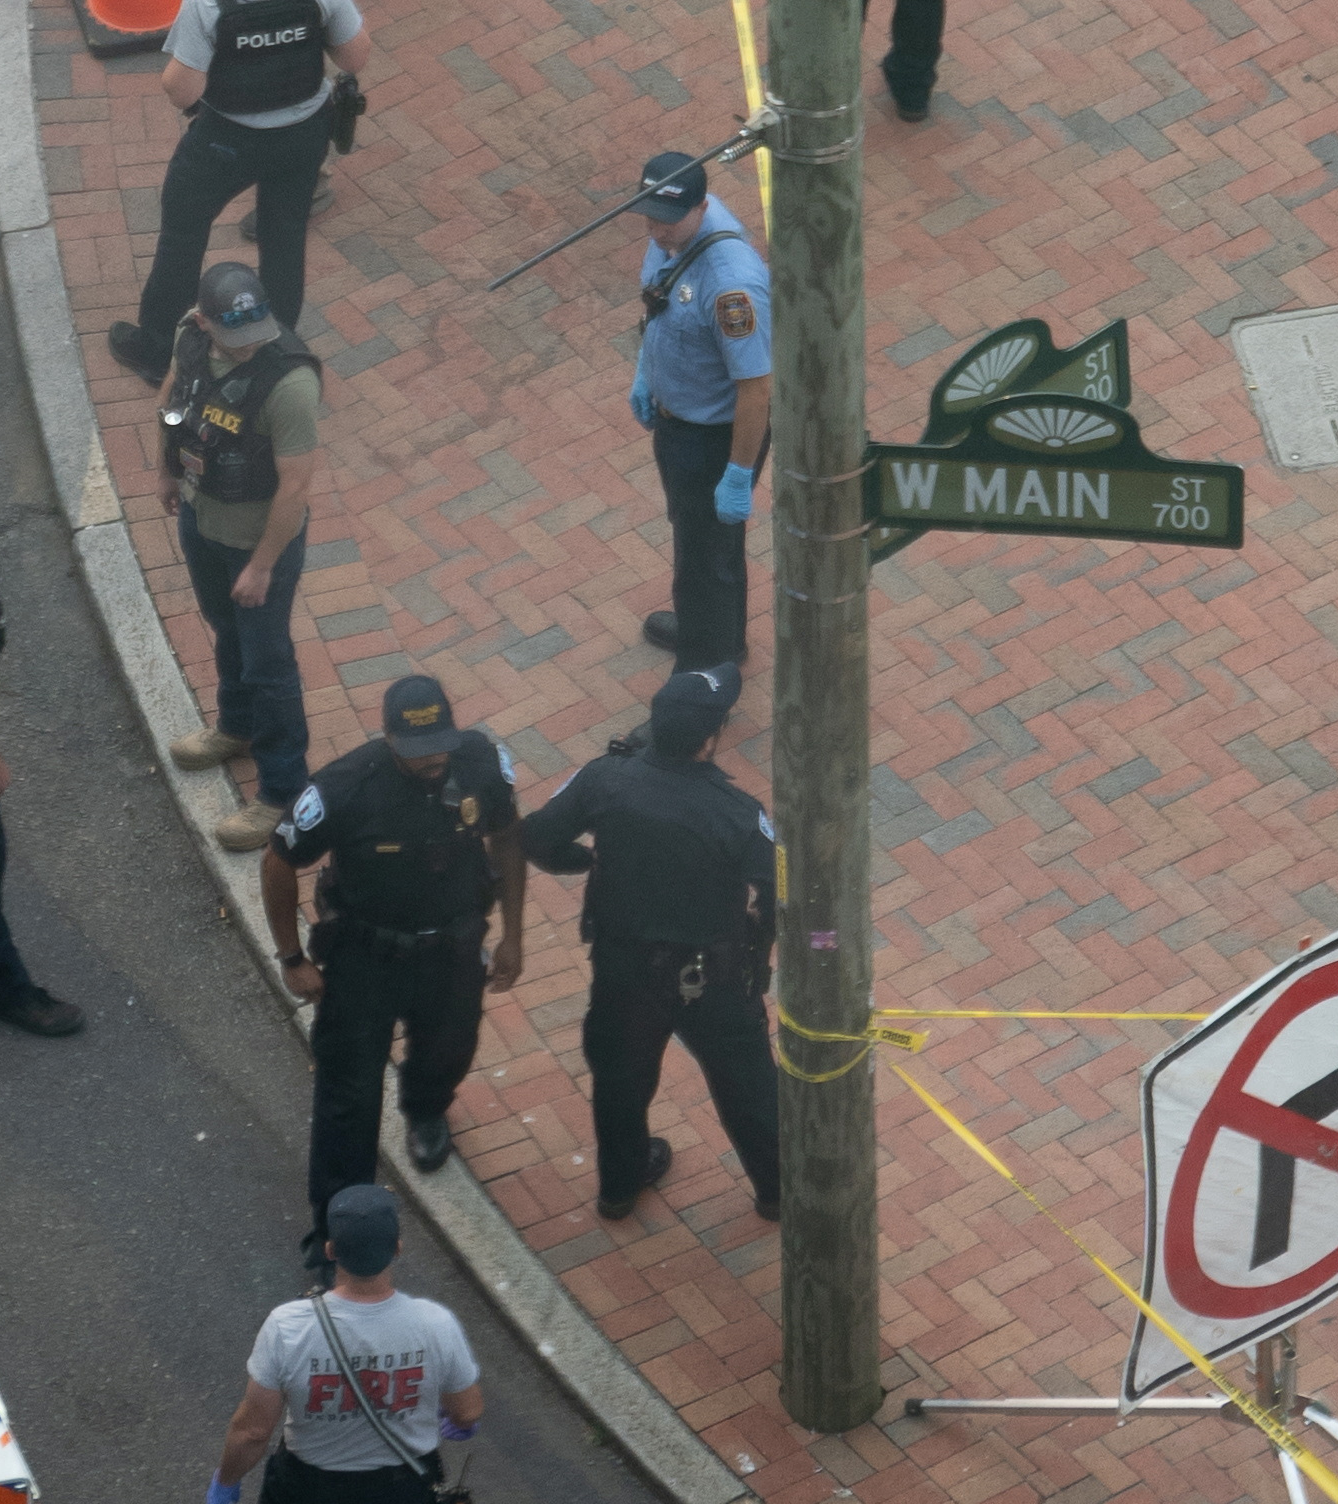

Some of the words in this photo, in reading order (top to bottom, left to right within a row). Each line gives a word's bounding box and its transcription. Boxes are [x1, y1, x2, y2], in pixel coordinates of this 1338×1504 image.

[236, 26, 307, 49] POLICE
[1085, 343, 1111, 381] ST
[202, 404, 243, 434] POLICE
[892, 462, 939, 512] W
[963, 466, 1111, 521] MAIN
[1169, 476, 1207, 503] ST
[1151, 502, 1211, 531] 700
[310, 1349, 425, 1373] RIHMOND
[307, 1366, 425, 1413] FIRE
